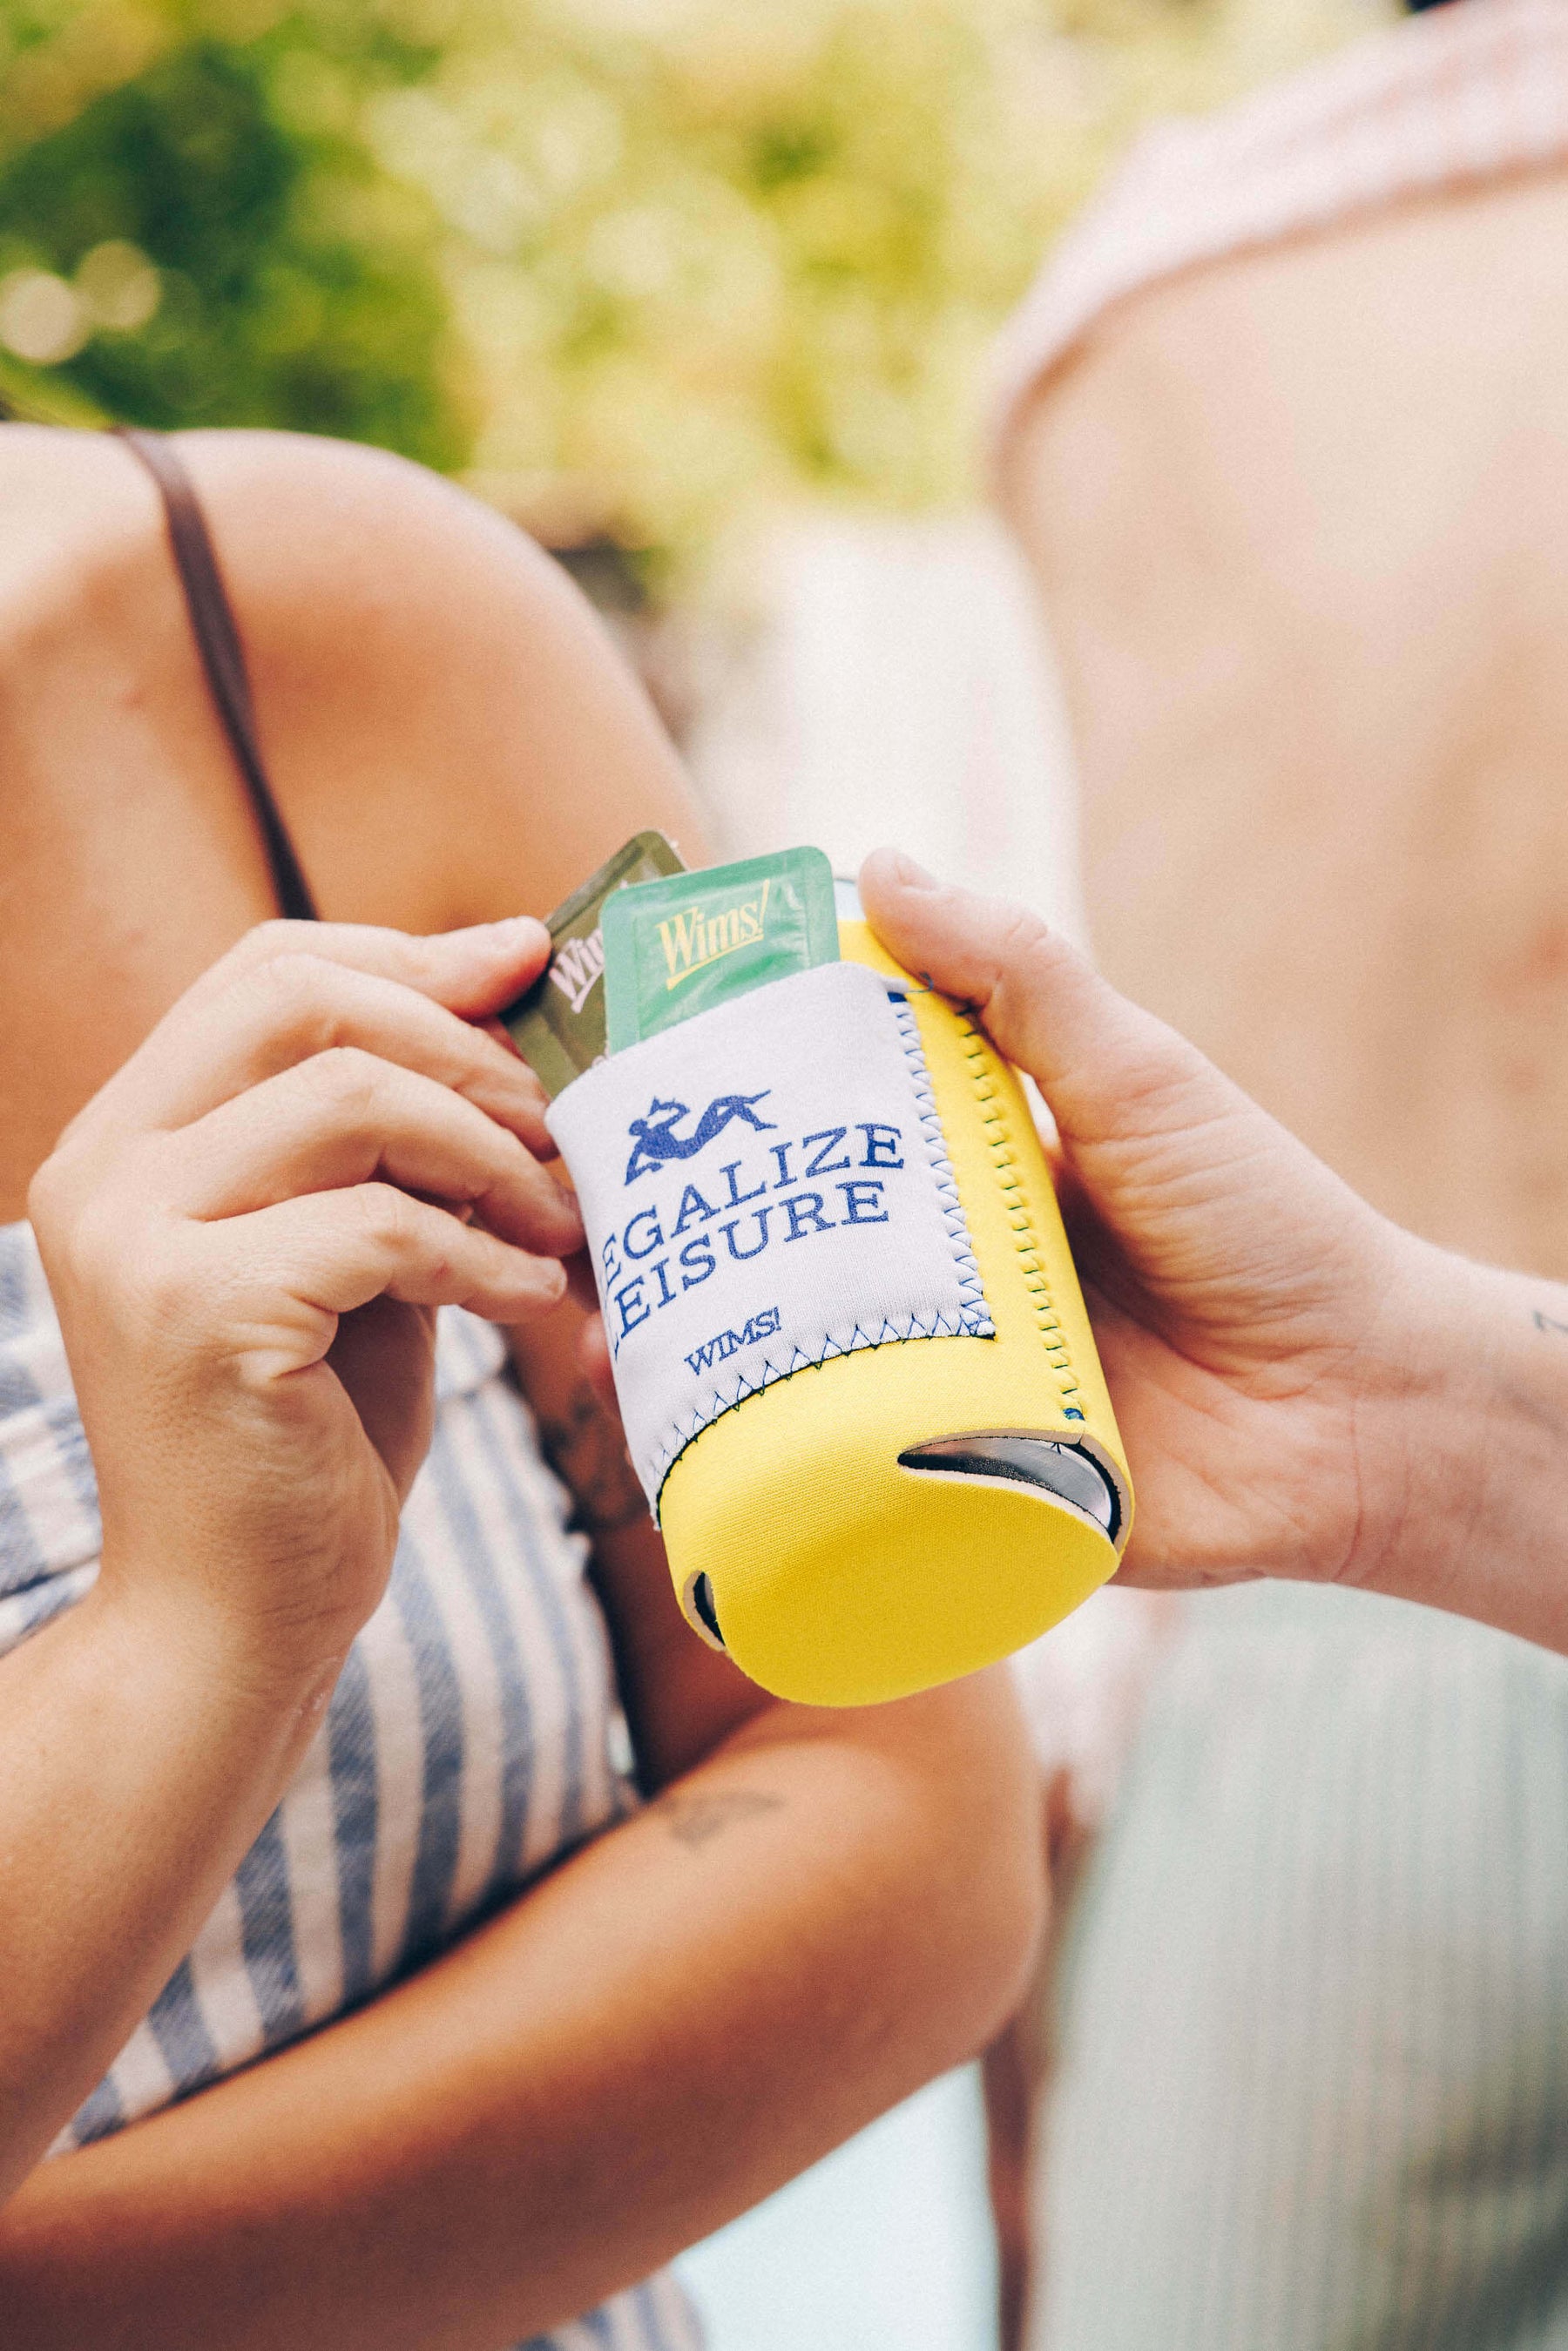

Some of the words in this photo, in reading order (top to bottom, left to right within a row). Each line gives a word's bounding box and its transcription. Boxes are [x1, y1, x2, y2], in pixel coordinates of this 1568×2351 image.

[655, 879, 770, 978] Wims!
[603, 1123, 904, 1287] EGALIZE
[684, 1306, 781, 1375] WIMS!
